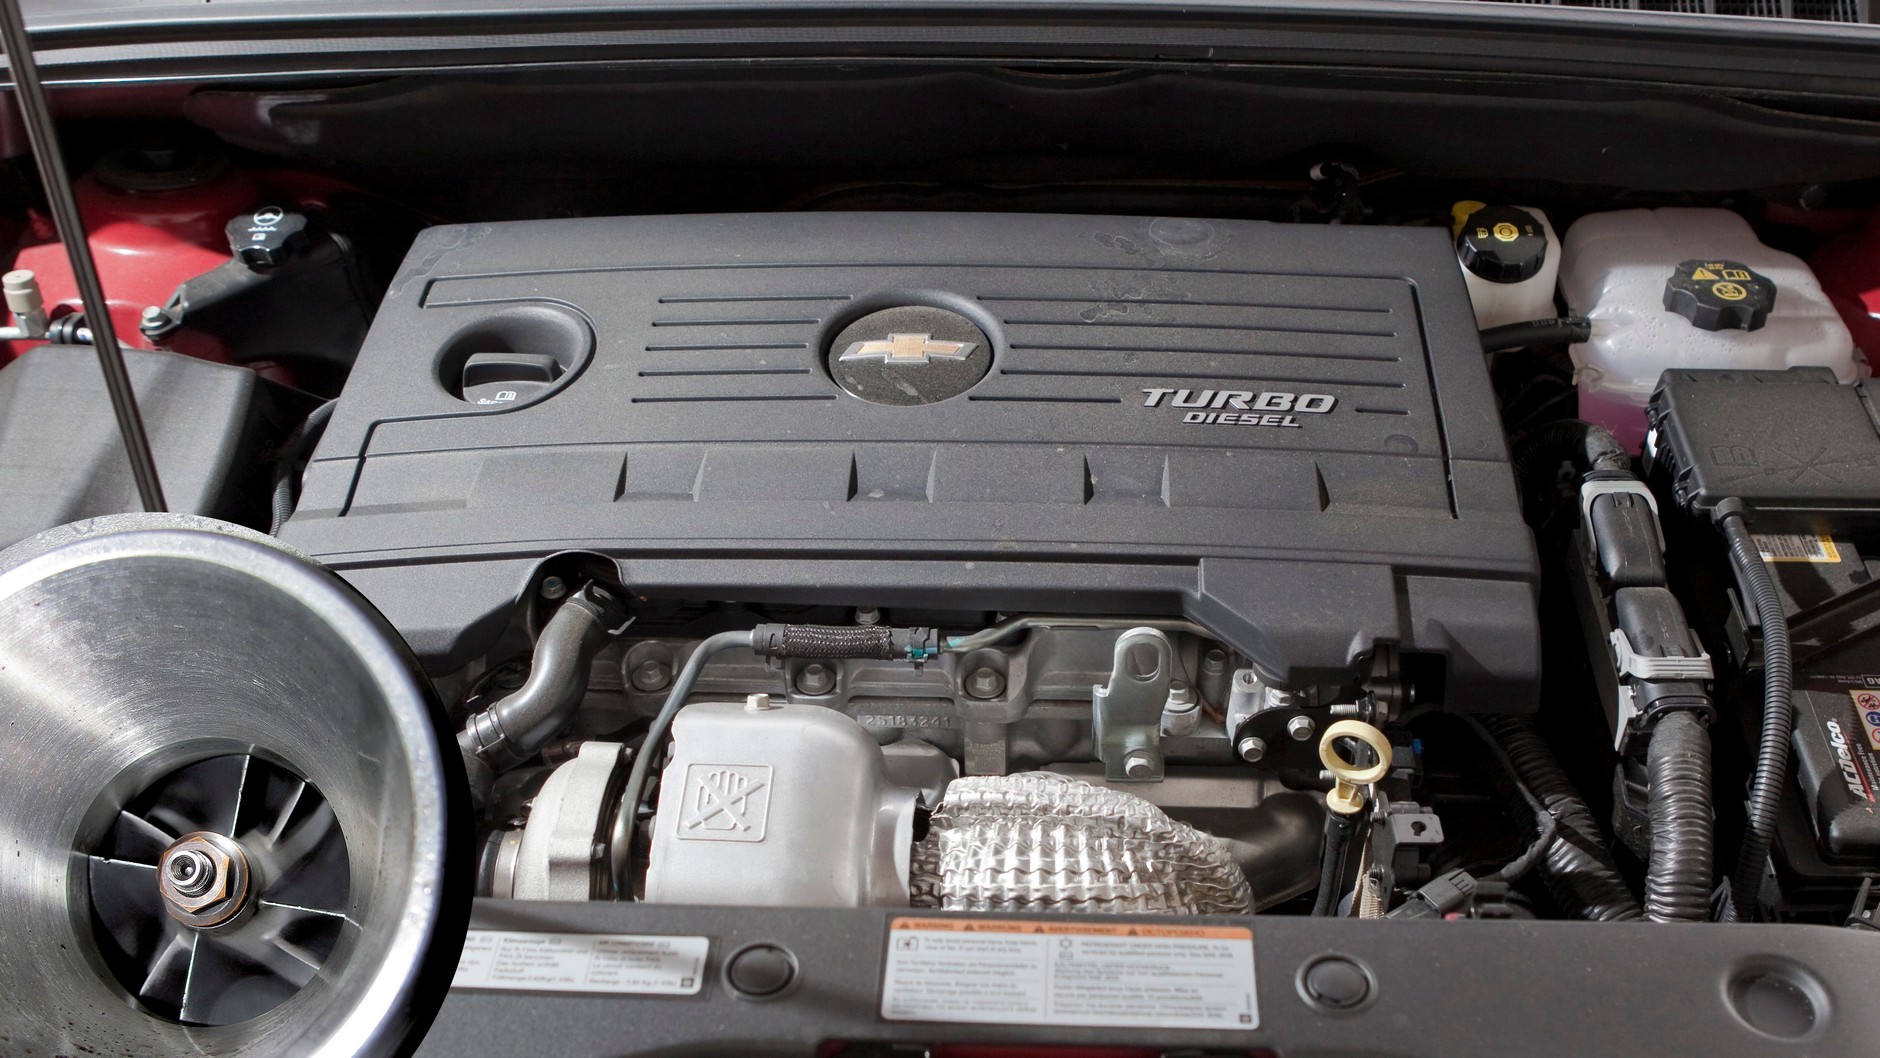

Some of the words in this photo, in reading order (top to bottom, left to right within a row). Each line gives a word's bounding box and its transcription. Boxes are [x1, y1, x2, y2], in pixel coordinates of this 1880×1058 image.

[1142, 388, 1338, 413] TURBO
[1182, 411, 1301, 428] DIESEL
[1826, 719, 1869, 800] ACDelco
